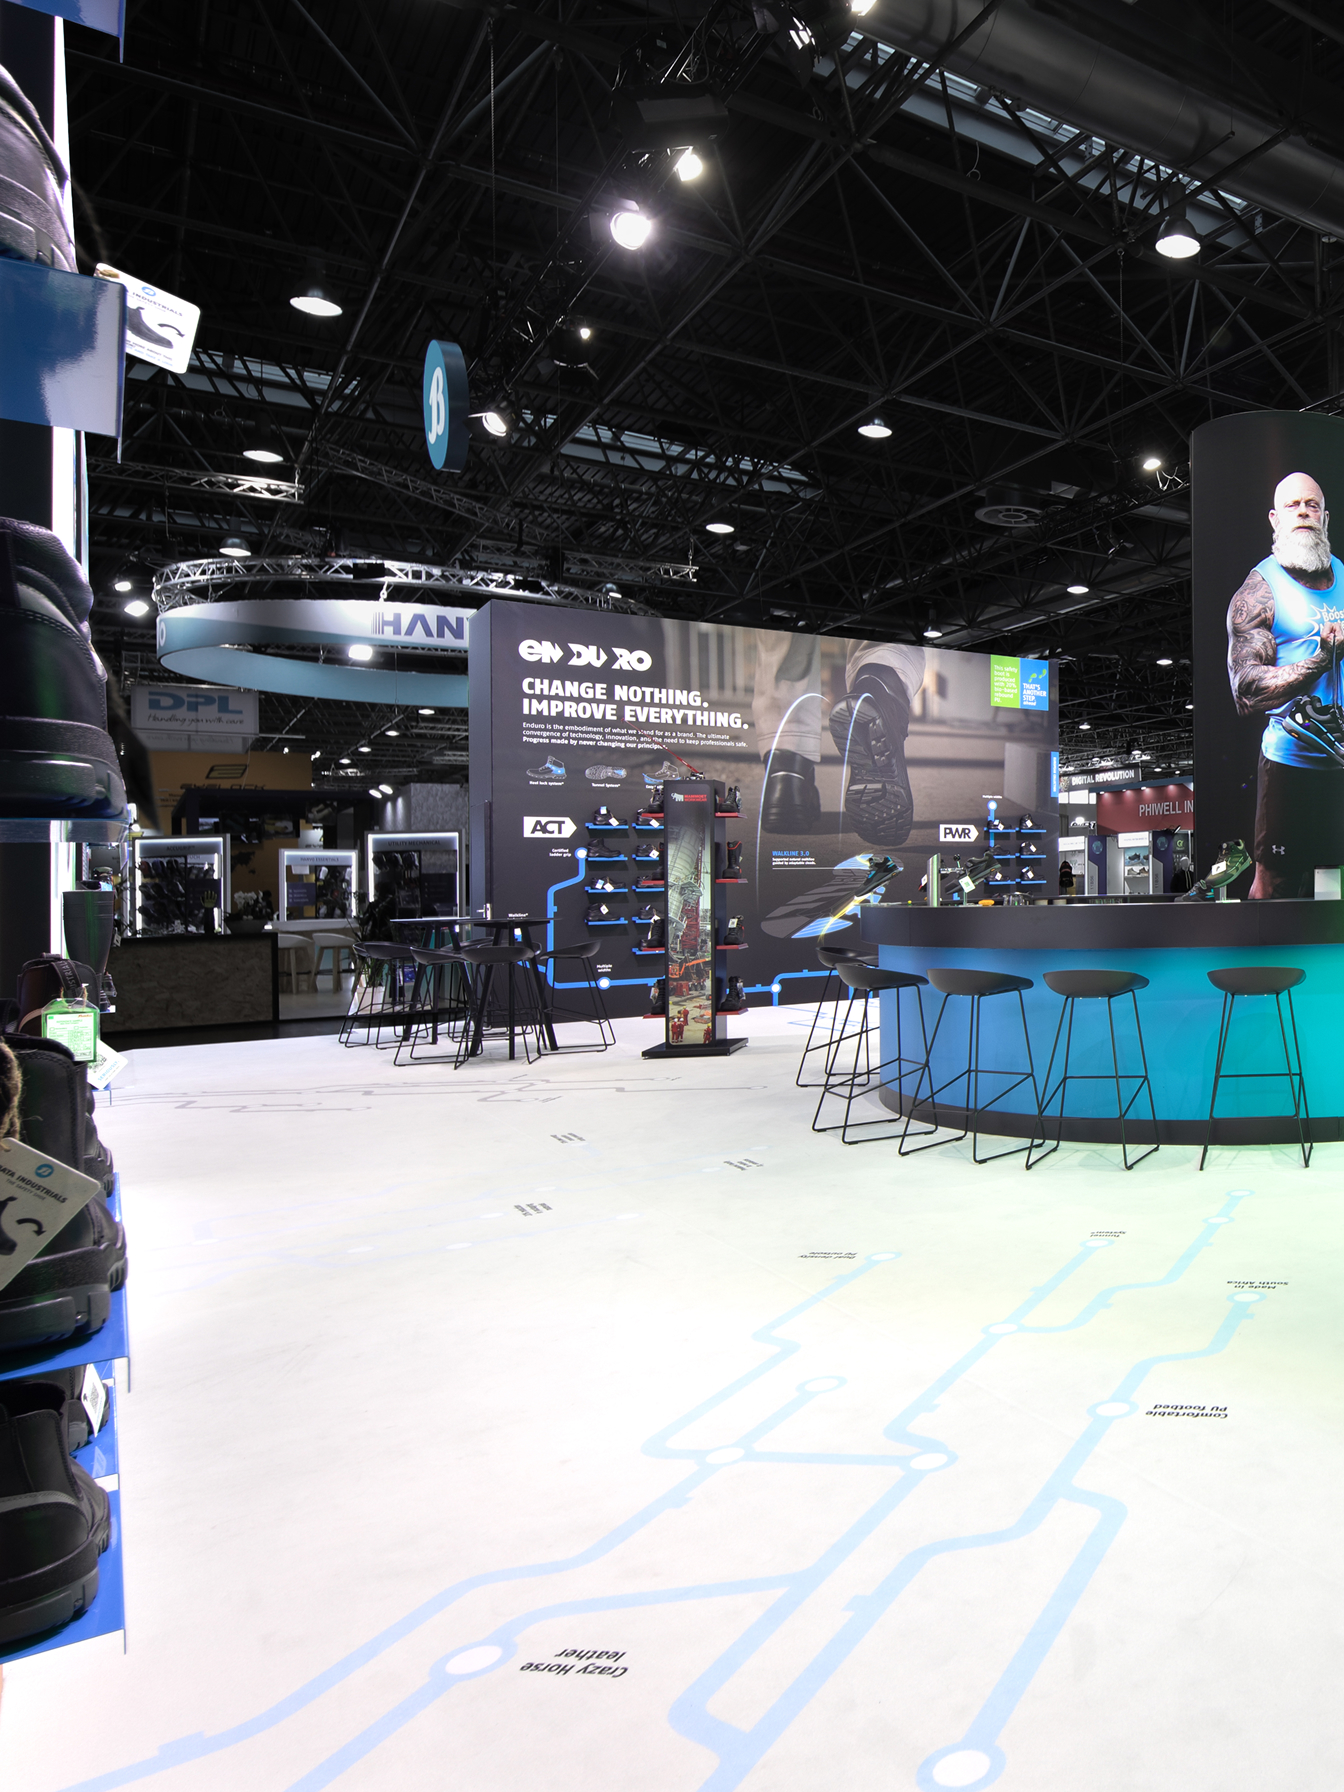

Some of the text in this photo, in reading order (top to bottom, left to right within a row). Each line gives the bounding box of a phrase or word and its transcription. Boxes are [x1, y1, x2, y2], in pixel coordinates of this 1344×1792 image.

[132, 292, 183, 316] INDUSTRIALS
[370, 612, 469, 640] HAN
[522, 678, 708, 708] CHANGE NOTHING.
[148, 691, 243, 714] DPL
[147, 713, 186, 726] Handling
[188, 718, 204, 726] you
[522, 698, 749, 730] IMPROVE EVERYTHING.
[1072, 770, 1135, 786] DIGITAL REVOLUTION
[1139, 801, 1182, 816] PHIWELL
[530, 820, 565, 834] ACT
[944, 827, 971, 839] PWR
[16, 1175, 68, 1203] INDUSTRIALS
[1145, 1410, 1228, 1419] Comfortable
[554, 1648, 627, 1663] leather
[520, 1662, 629, 1678] Crazy Horse
